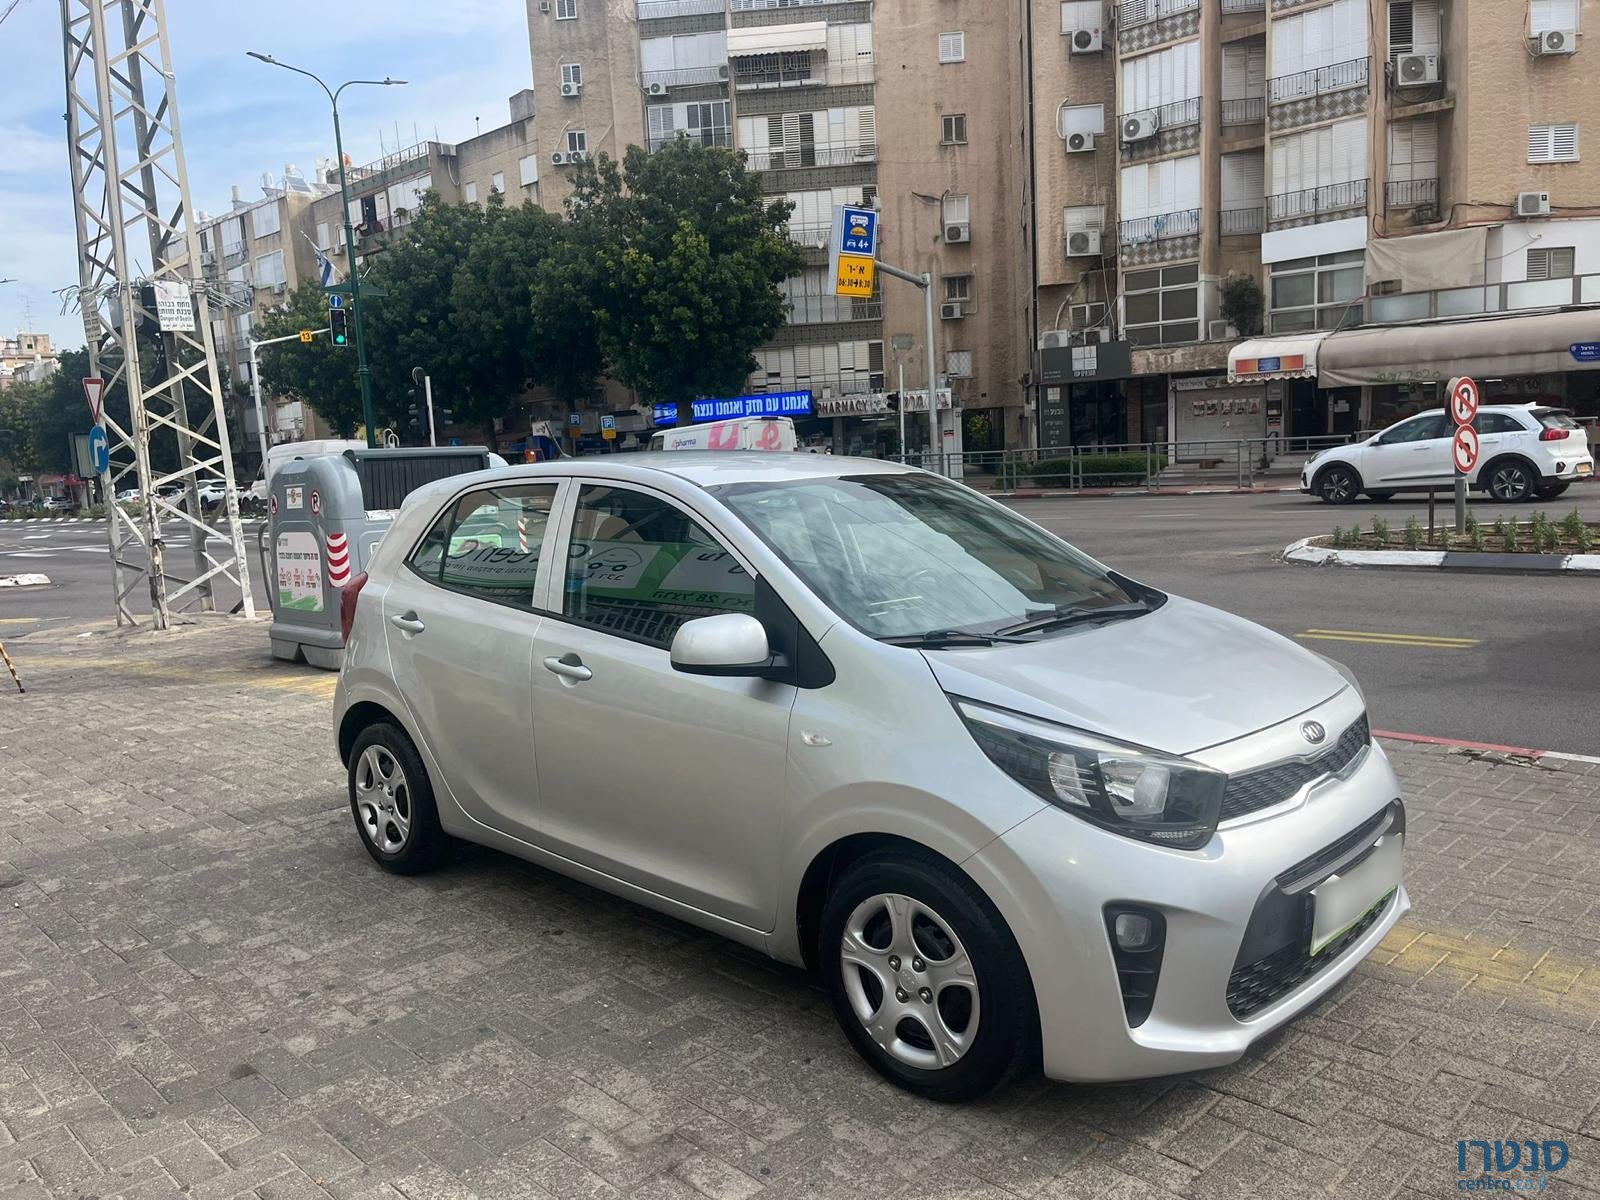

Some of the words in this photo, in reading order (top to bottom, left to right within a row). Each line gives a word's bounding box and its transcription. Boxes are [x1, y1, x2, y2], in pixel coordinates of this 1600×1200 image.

[301, 332, 310, 340] 13
[716, 401, 743, 415] ואנחנו
[746, 399, 763, 415] חזק
[766, 398, 779, 412] עם
[782, 395, 809, 410] אנחנו
